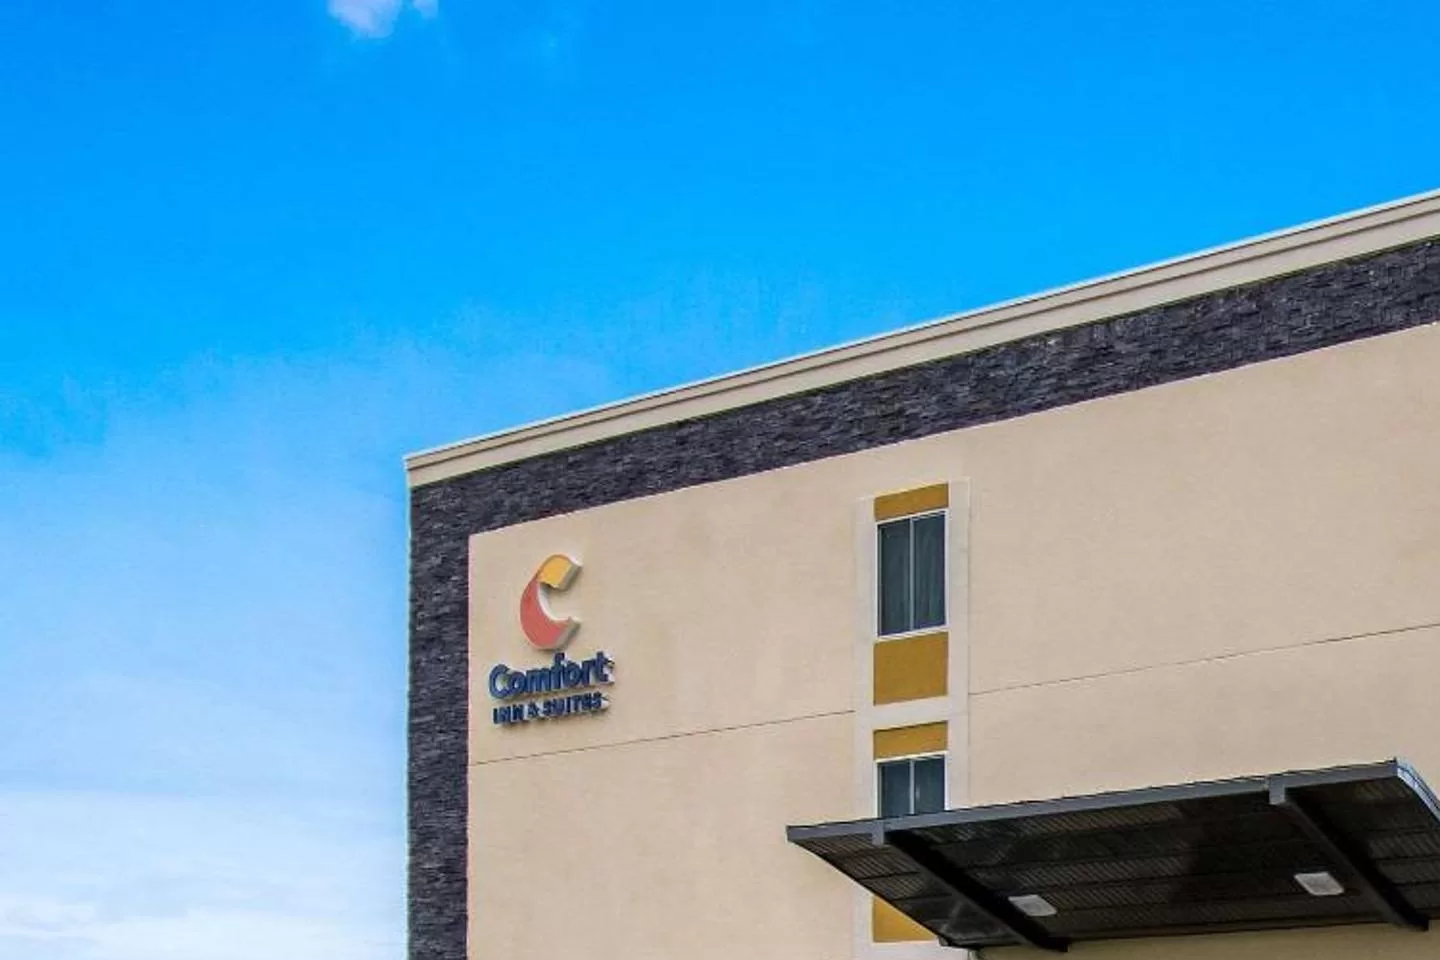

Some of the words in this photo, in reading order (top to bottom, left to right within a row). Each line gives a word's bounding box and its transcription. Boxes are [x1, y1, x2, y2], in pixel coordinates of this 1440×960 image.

[489, 651, 614, 699] Comfort
[493, 704, 524, 724] INN
[542, 692, 608, 716] SUITES
